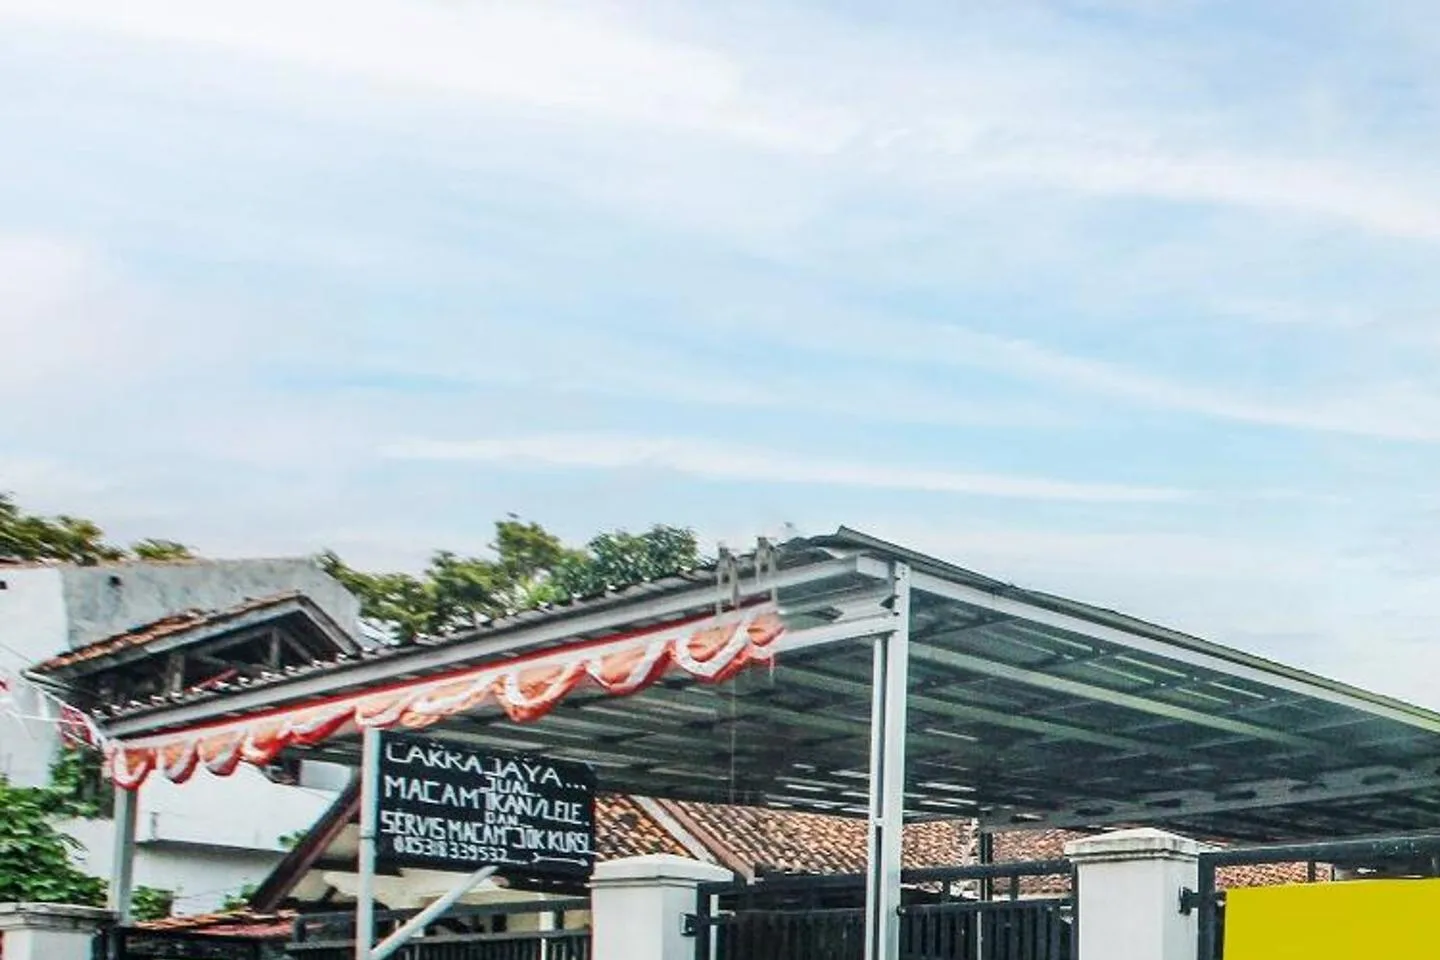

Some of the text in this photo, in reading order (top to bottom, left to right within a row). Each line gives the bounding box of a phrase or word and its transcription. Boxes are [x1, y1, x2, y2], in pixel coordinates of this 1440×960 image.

[384, 775, 479, 809] MACAM
[381, 809, 447, 840] SERVIS
[447, 819, 507, 846] MACAM
